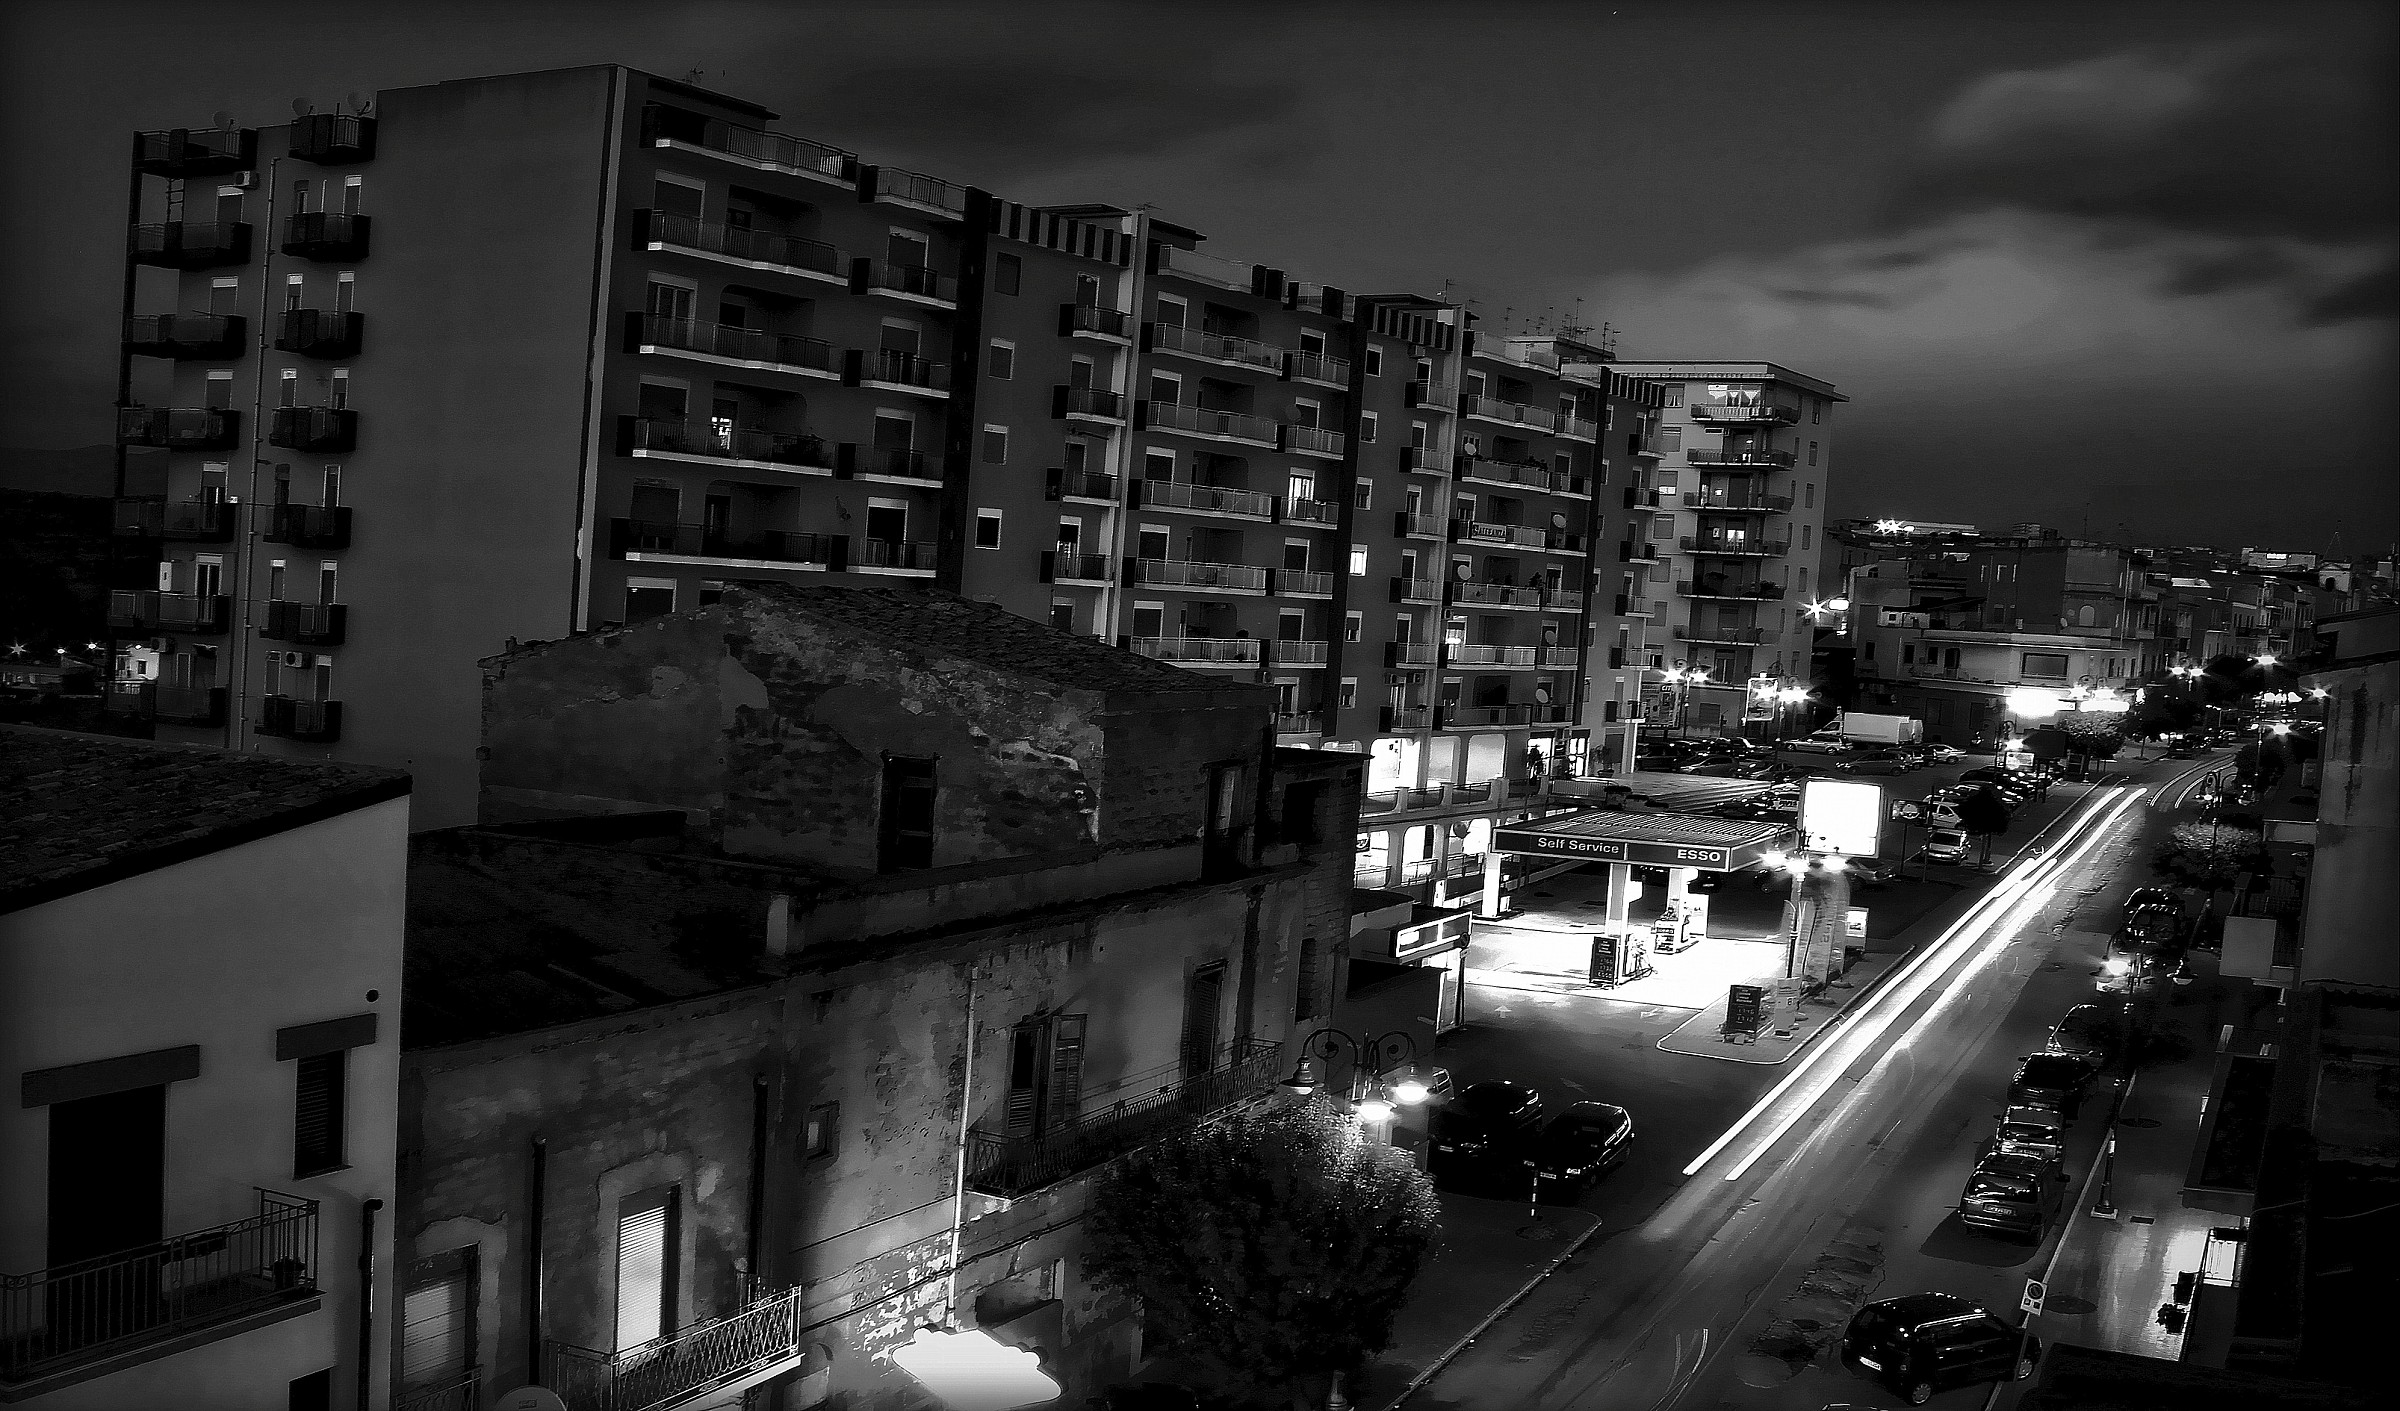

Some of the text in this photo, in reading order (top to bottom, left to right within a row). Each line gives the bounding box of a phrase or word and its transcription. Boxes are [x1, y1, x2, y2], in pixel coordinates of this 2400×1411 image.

[1538, 837, 1620, 854] Self Service
[1677, 849, 1721, 862] ESSO
